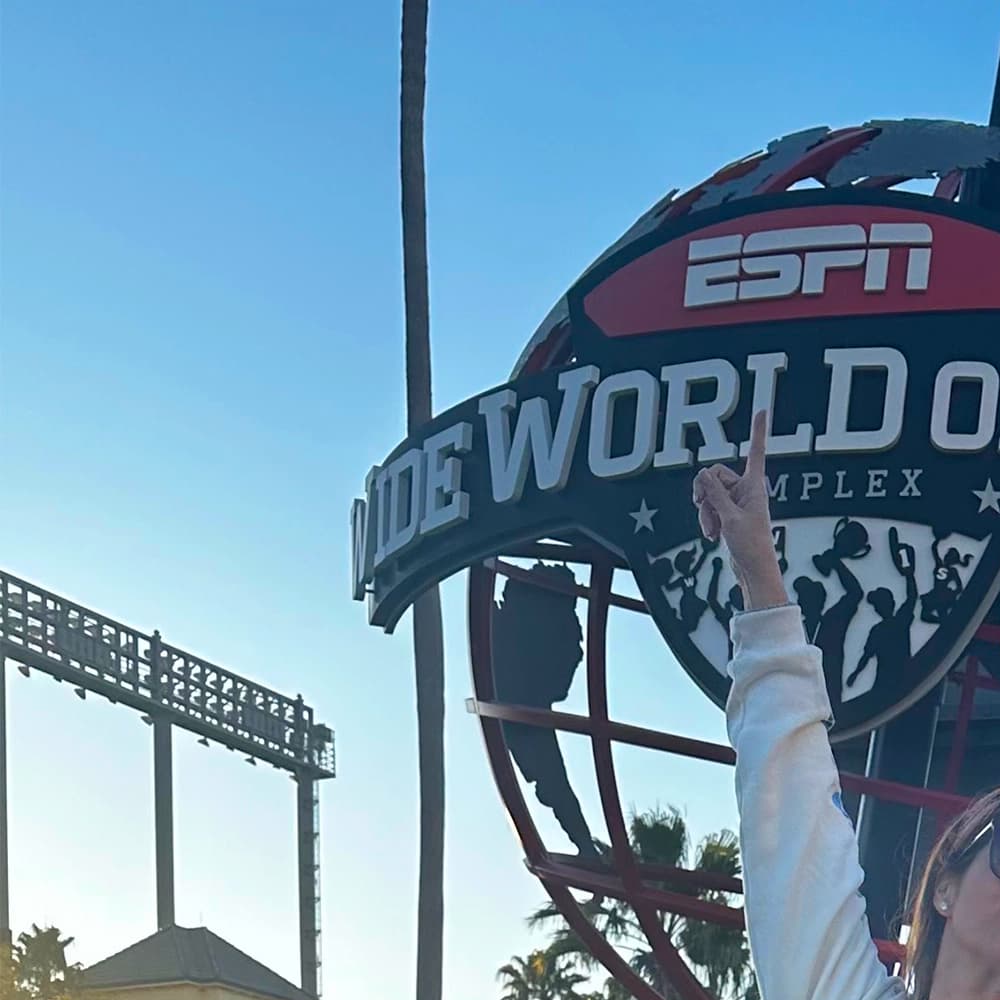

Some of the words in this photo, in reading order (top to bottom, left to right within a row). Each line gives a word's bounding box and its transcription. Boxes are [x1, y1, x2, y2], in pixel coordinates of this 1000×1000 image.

[683, 222, 934, 308] ESPN
[478, 346, 909, 503] WORLD
[766, 468, 923, 502] MPLEX
